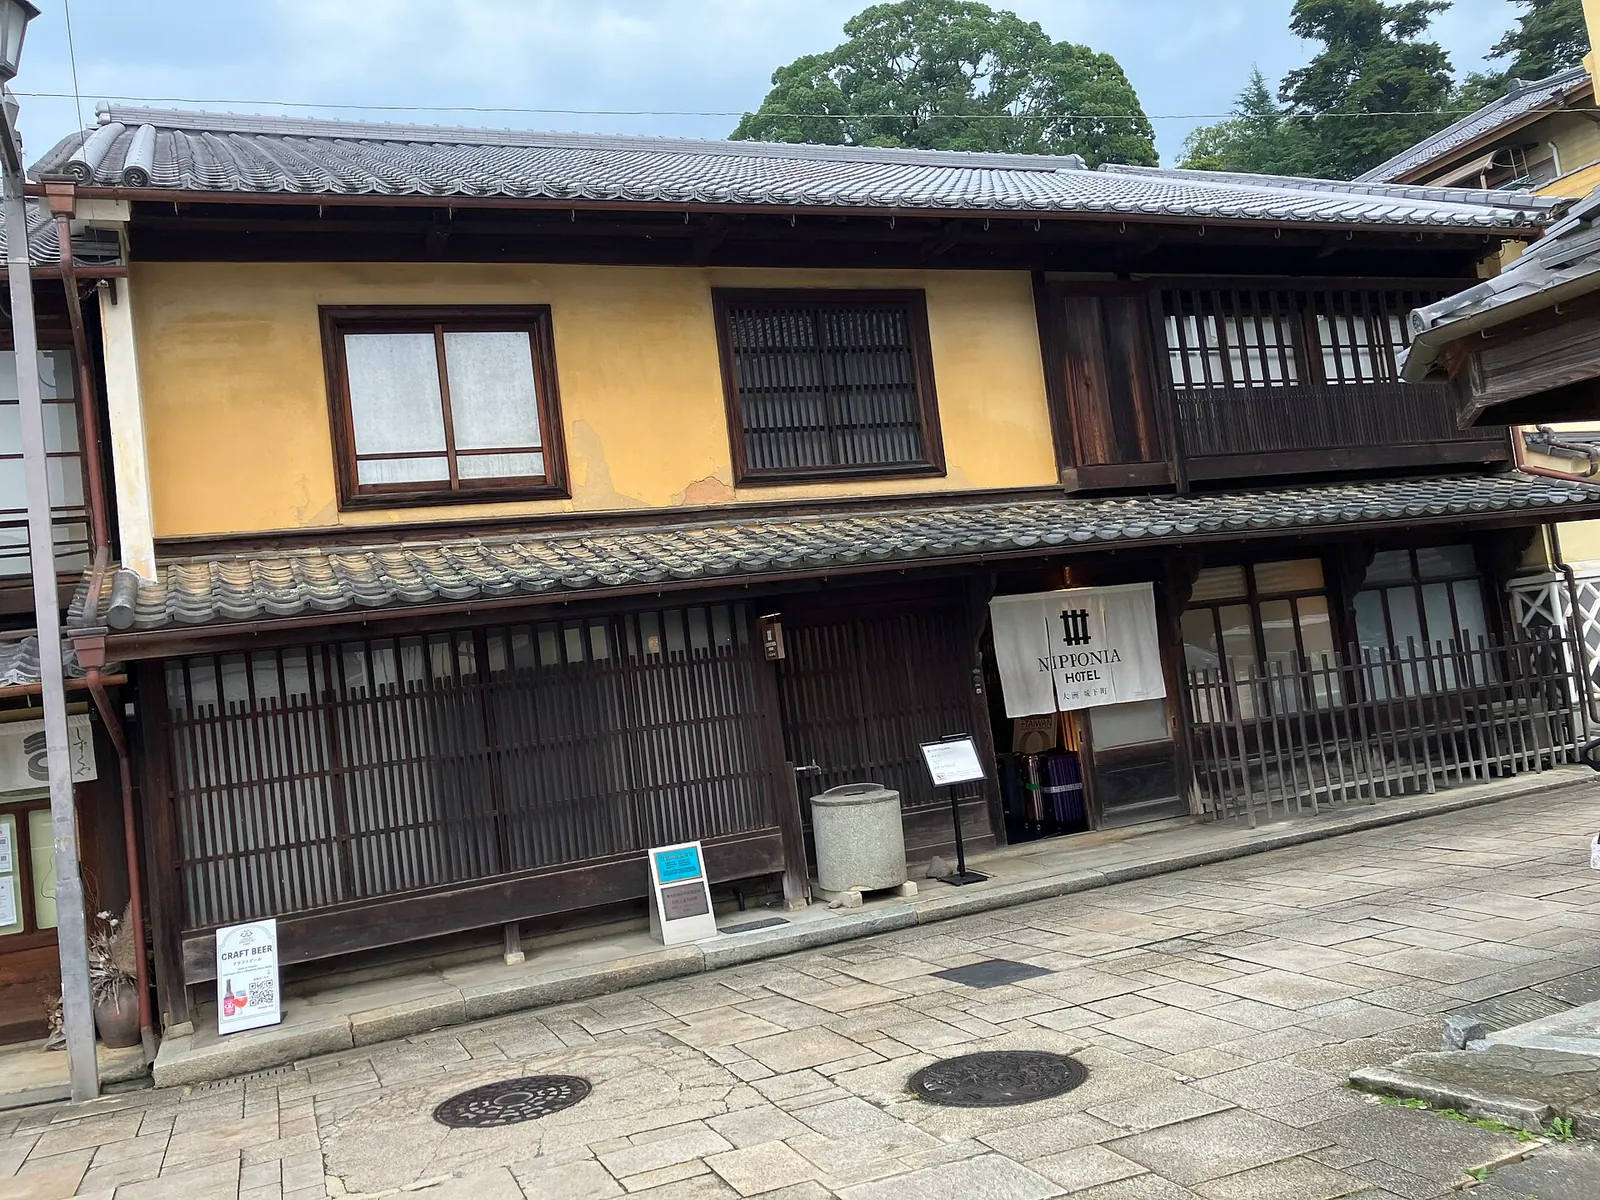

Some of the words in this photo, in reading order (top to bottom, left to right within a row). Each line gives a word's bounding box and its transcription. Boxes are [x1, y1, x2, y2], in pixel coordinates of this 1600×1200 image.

[1038, 649, 1121, 672] NIPPONIA
[1065, 669, 1101, 684] HOTEL
[221, 948, 250, 961] CRAFT
[251, 944, 273, 956] BEER
